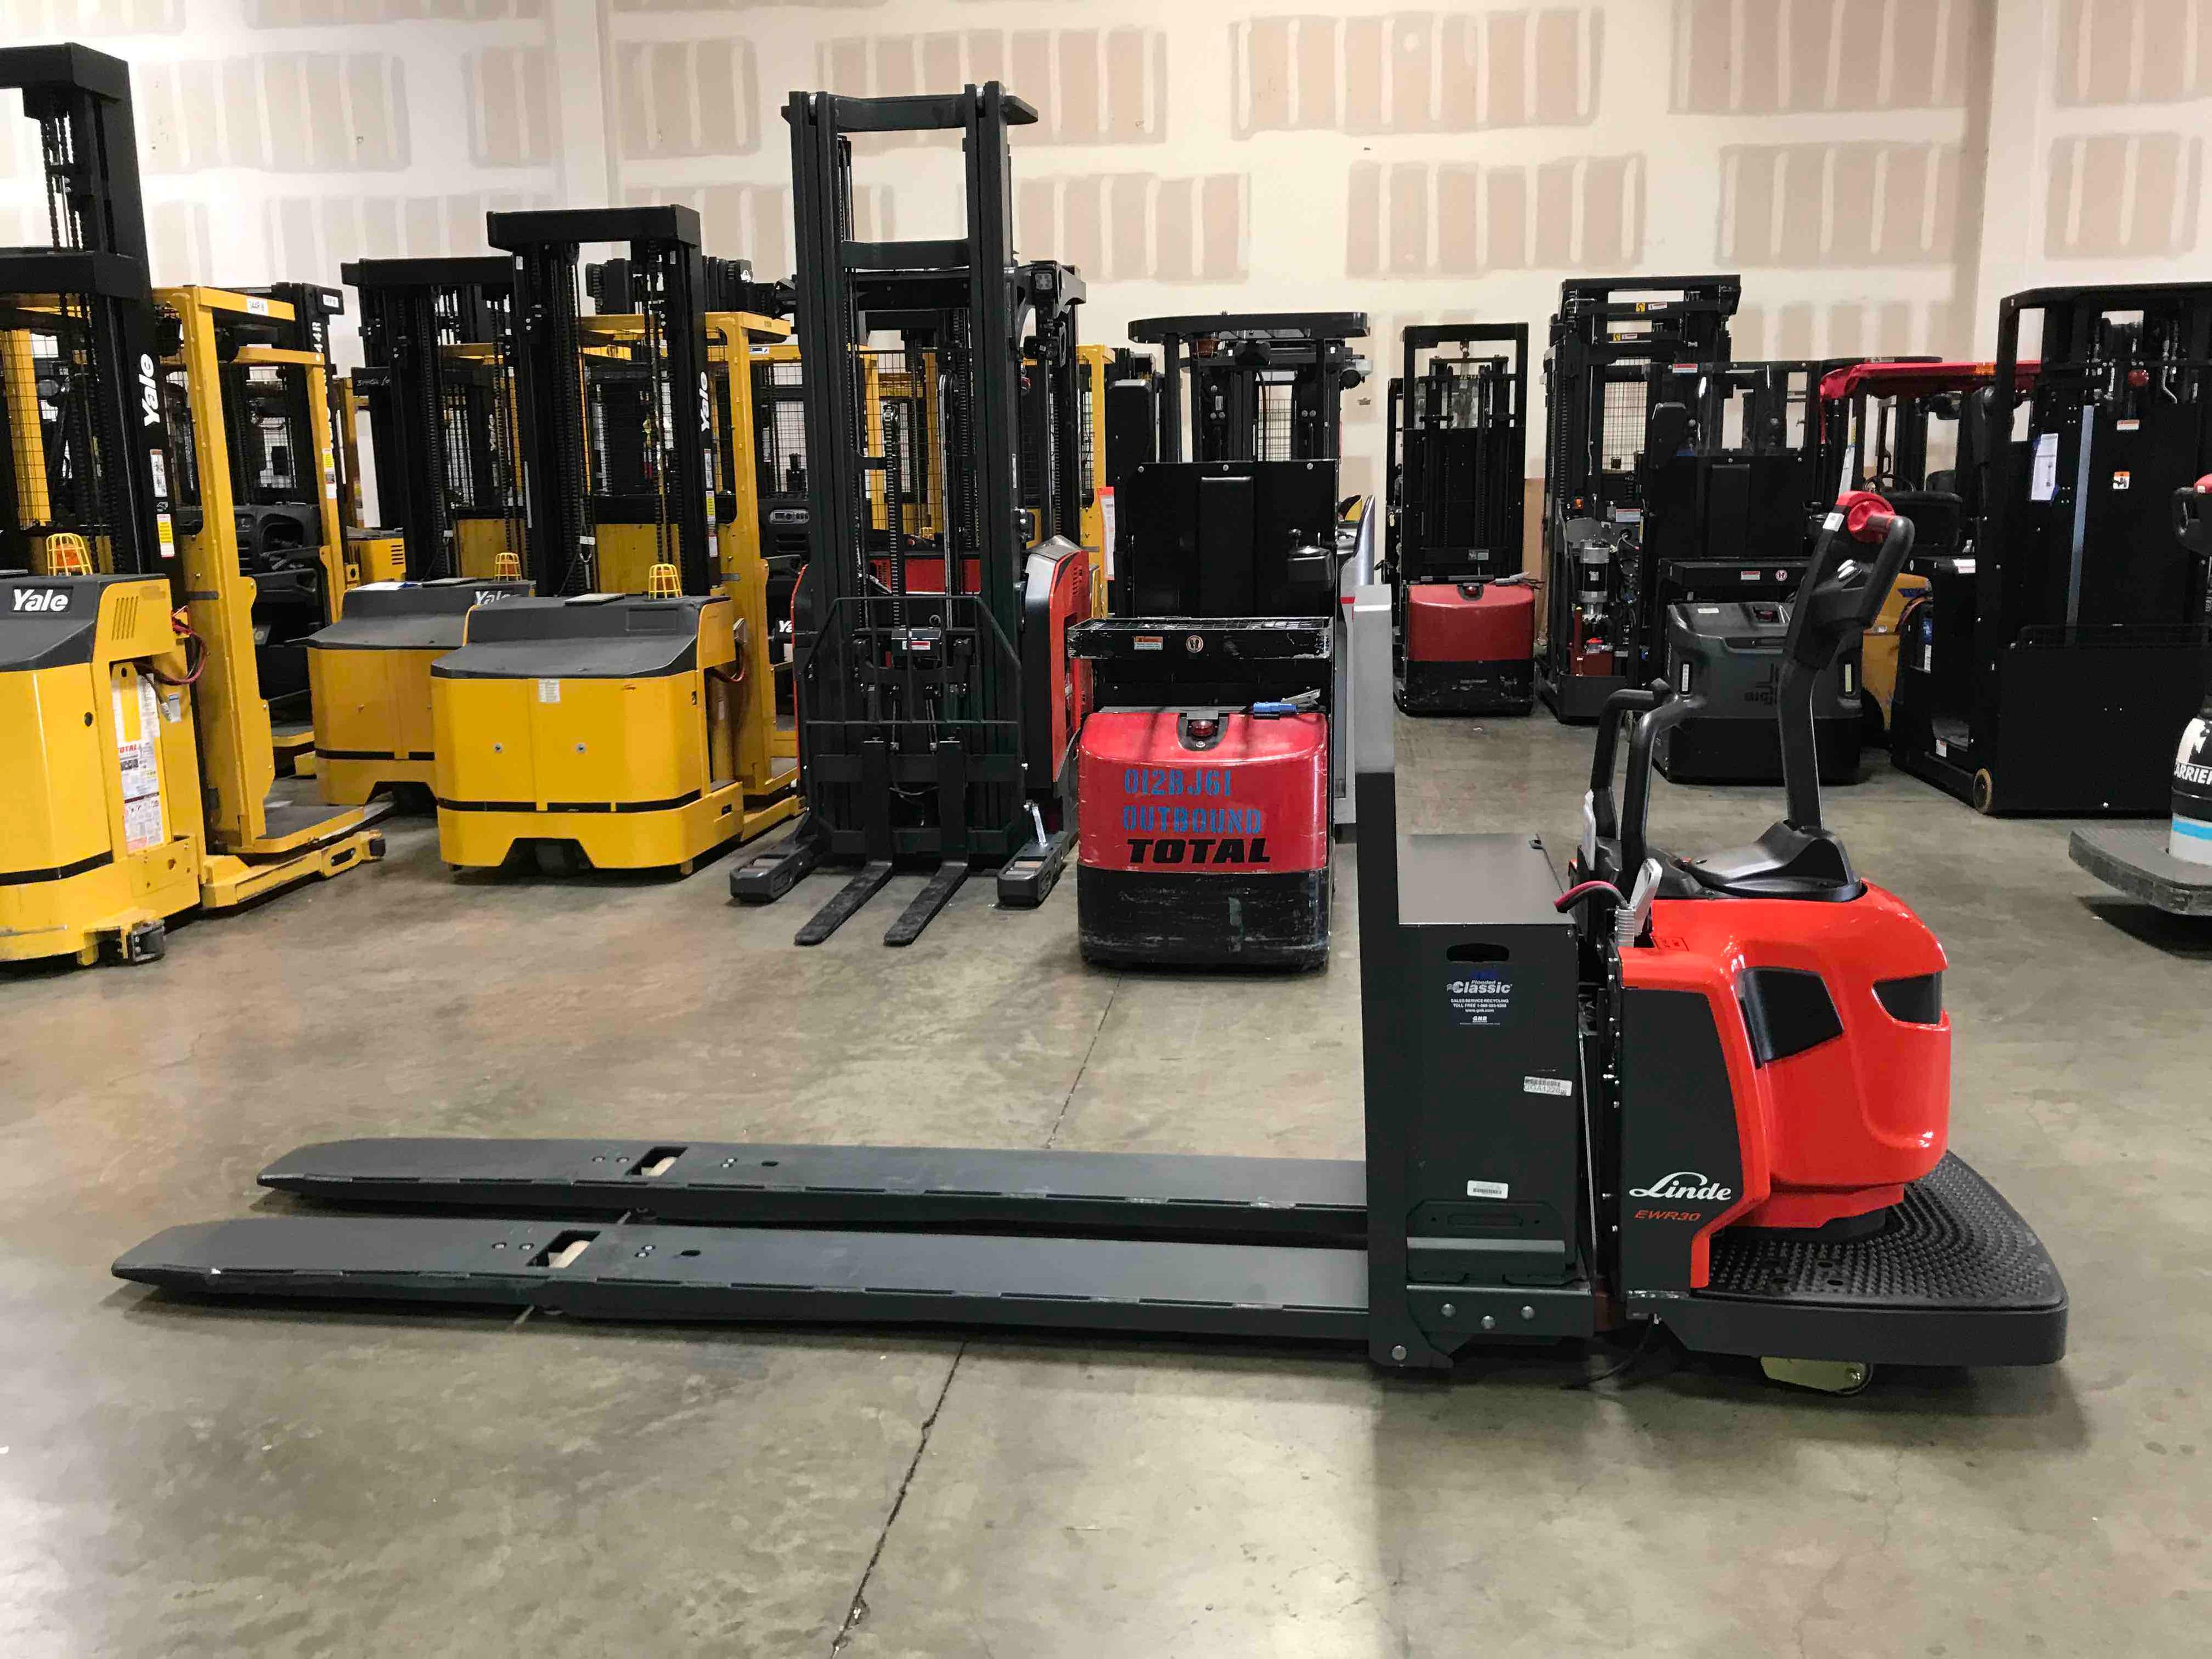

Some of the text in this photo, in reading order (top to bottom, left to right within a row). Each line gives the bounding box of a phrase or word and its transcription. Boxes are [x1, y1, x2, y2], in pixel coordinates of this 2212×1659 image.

[138, 354, 160, 426] Yale
[699, 371, 710, 432] Yale
[13, 589, 69, 612] Yale
[779, 620, 793, 633] Ya
[1123, 805, 1262, 834] OUTBOUND
[1127, 838, 1271, 863] TOTAL
[1452, 981, 1510, 994] Classic
[1629, 1171, 1732, 1200] Linde
[1634, 1210, 1702, 1222] EWR30
